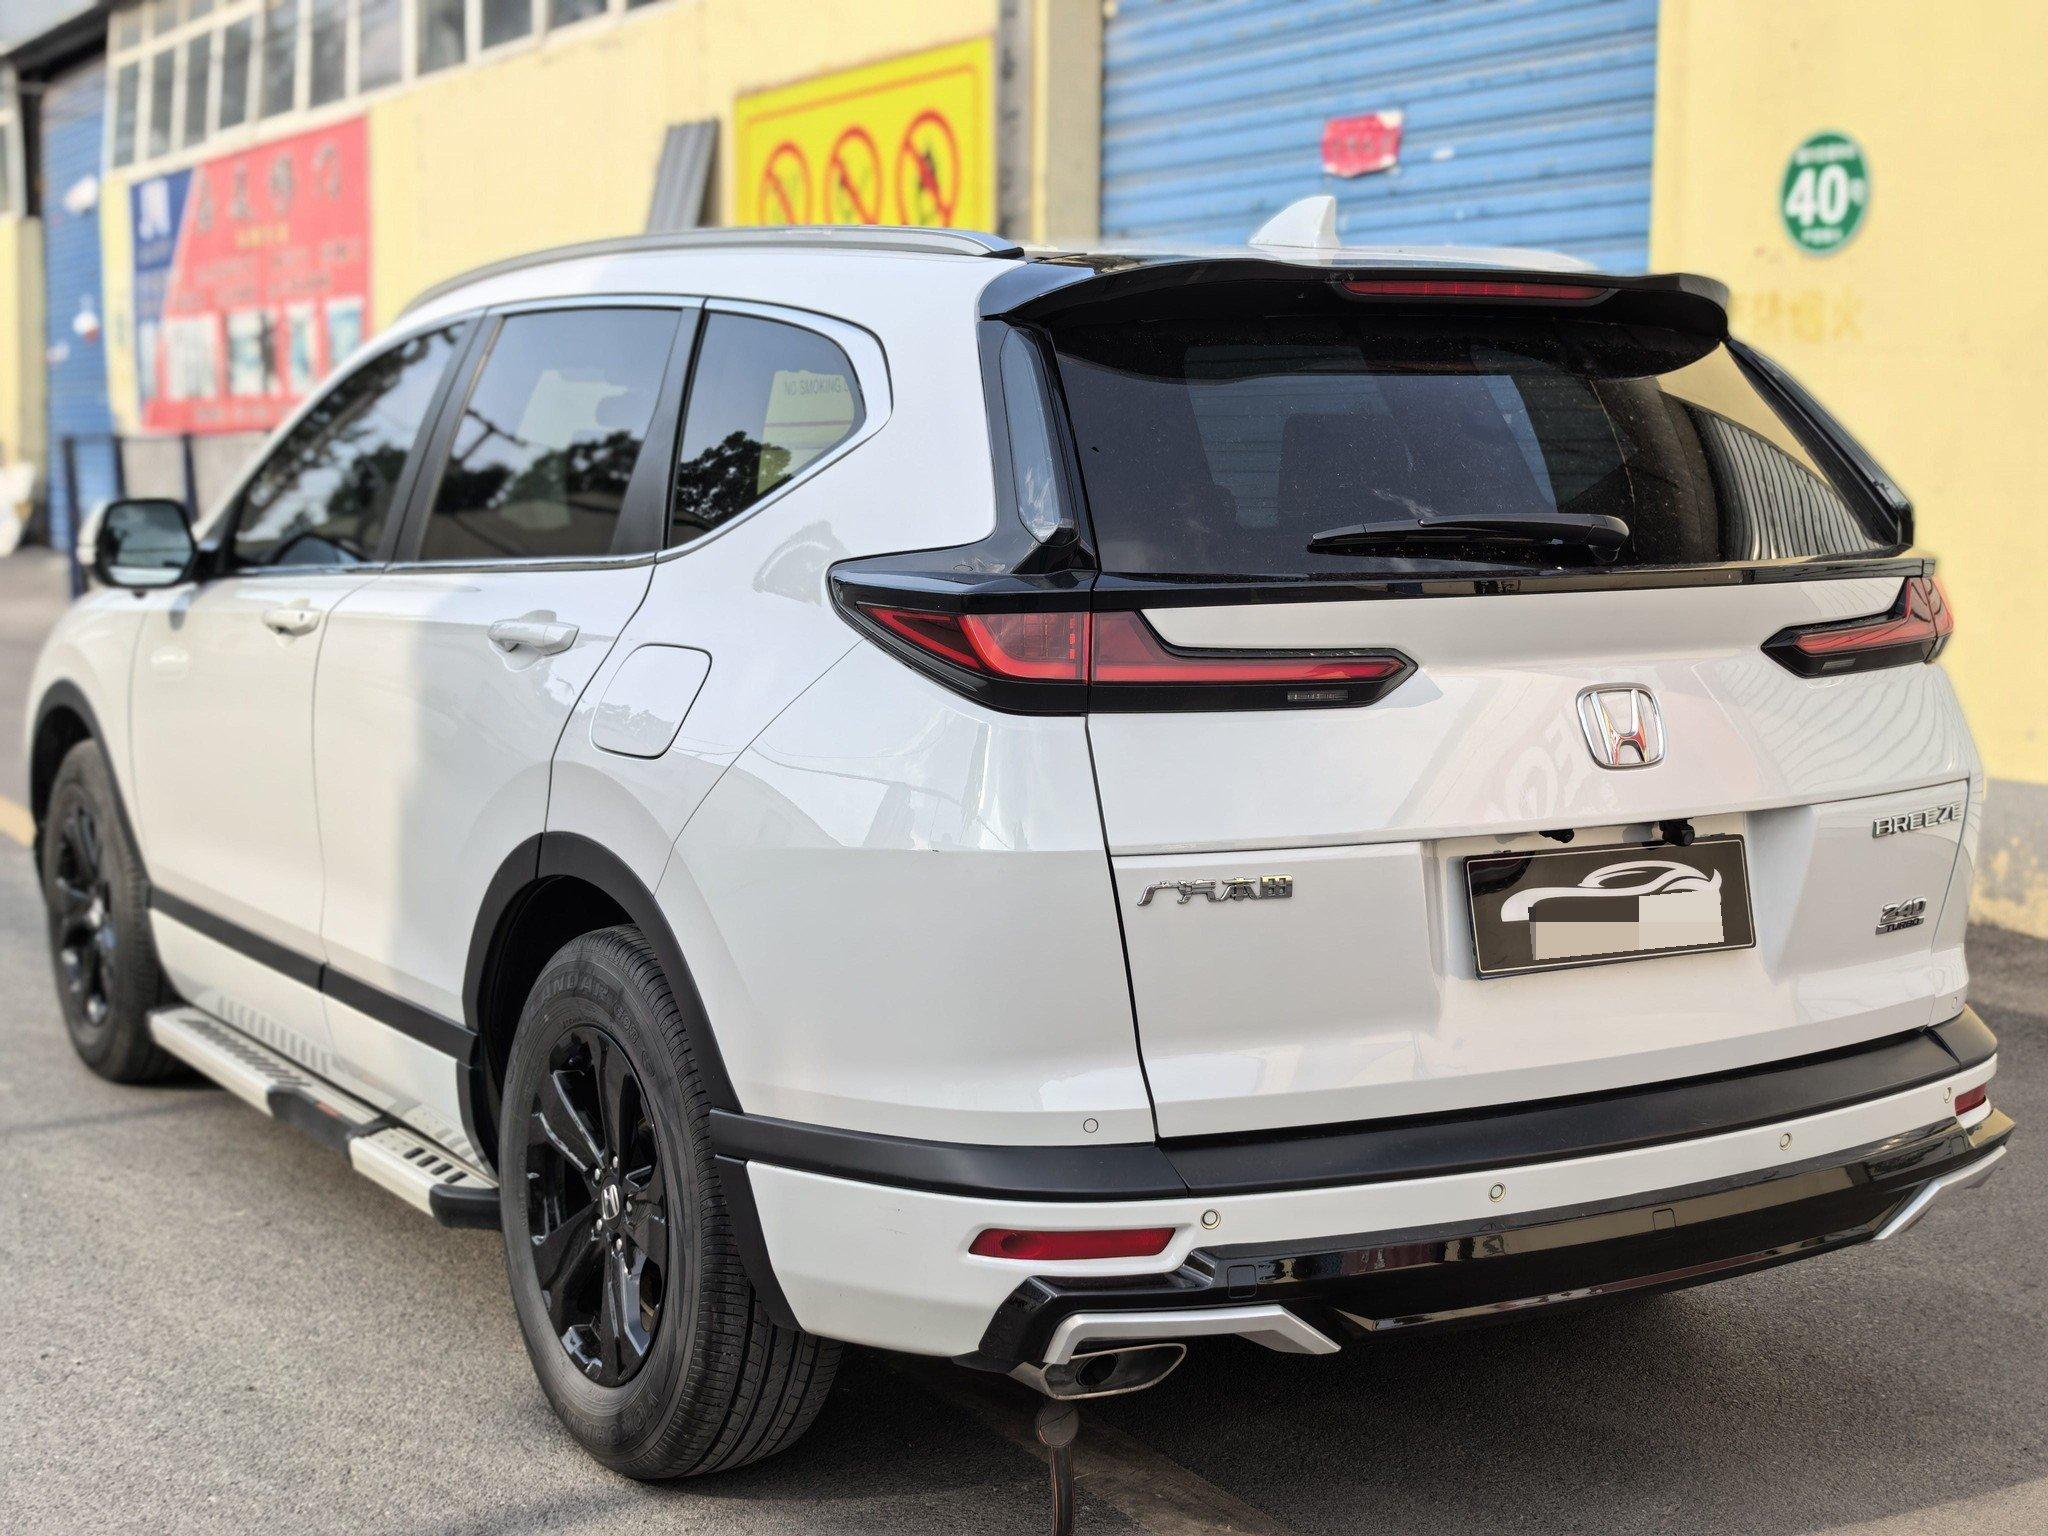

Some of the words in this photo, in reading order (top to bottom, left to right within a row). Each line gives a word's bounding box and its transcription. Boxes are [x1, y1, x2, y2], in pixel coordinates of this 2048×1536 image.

[1786, 166, 1849, 225] 40
[1873, 801, 1962, 838] BREEZE
[1137, 874, 1293, 907] 广汽本田
[1881, 897, 1927, 923] 240
[1885, 917, 1921, 933] TURBO
